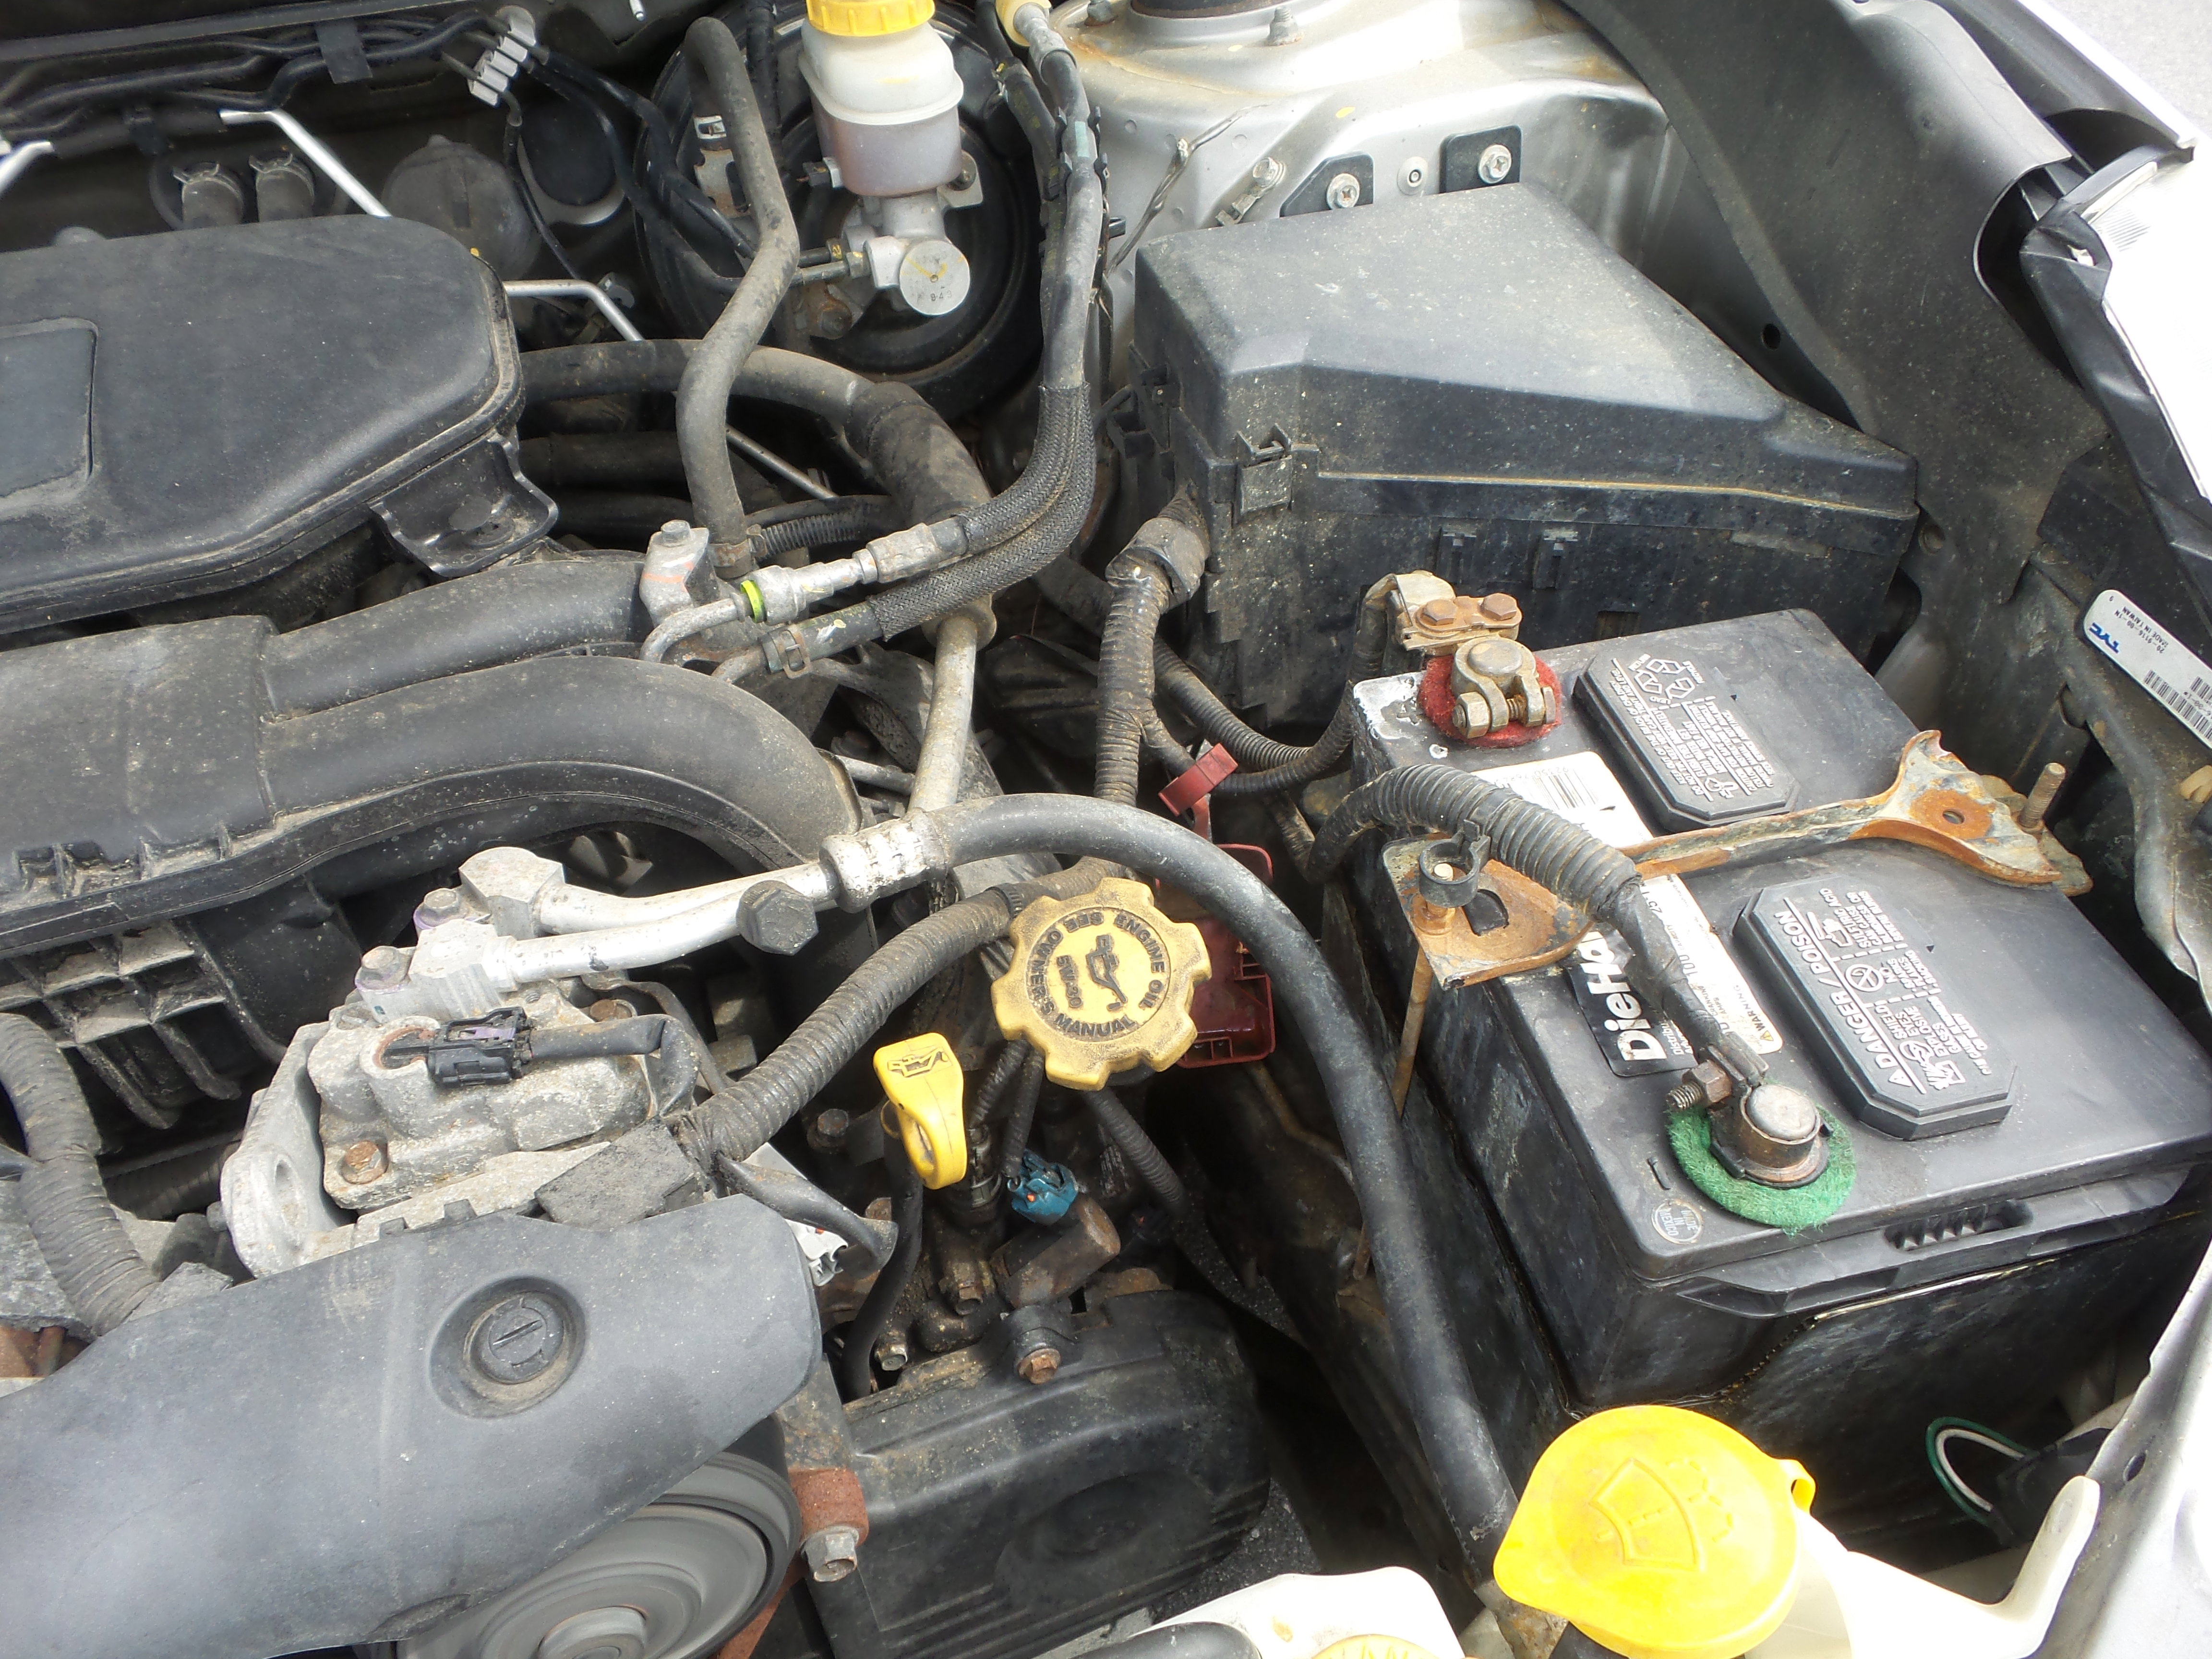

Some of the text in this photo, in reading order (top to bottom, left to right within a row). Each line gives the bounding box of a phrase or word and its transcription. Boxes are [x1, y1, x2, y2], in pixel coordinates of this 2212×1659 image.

[2123, 607, 2143, 626] TAIWAN
[2089, 623, 2118, 653] TYC
[2152, 633, 2168, 647] MADE
[1683, 661, 1705, 684] RECYCLE
[1622, 685, 1635, 696] AND
[1649, 696, 1671, 705] LEAD
[1630, 697, 1647, 713] TIGHT
[1633, 716, 1651, 734] REACH
[1642, 714, 1658, 729] CAPS
[1646, 734, 1659, 746] THE
[1652, 730, 1669, 744] VENT
[1653, 710, 1707, 777] FLUSH EYES IMMEDIATELY
[1677, 729, 1691, 739] GET
[1731, 735, 1742, 743] IF
[1655, 746, 1666, 755] OF
[1663, 744, 1679, 759] KEEP
[1683, 721, 1727, 773] MEDICAL HELP FAST
[1716, 743, 1731, 756] SAFE
[1744, 741, 1765, 760] SERVICE
[1661, 756, 1675, 769] OUT
[1700, 760, 1717, 775] WITH
[1726, 756, 1739, 768] FOR
[1760, 761, 1775, 774] SEEK
[1670, 769, 1687, 784] KEEP
[1683, 773, 1696, 785] NOT
[1744, 767, 1765, 787] FOLLOW
[1691, 785, 1704, 794] DO
[1064, 912, 1104, 932] SEE
[1820, 888, 1871, 947] SULFURIC ACID
[1845, 905, 1885, 945] CAN CAUSE
[1847, 892, 1893, 943] BLINDNESS OR
[1859, 891, 1903, 940] SEVERE BURNS
[1114, 913, 1165, 1009] ENGINE OIL
[1905, 950, 1936, 983] SMOKING
[1877, 966, 1898, 983] NO
[1885, 958, 1915, 988] SPARKS
[1898, 957, 1925, 986] FLAMES
[1775, 911, 1897, 1069] DANGER / POISON
[1732, 985, 1766, 1031] WARNING
[1928, 996, 1961, 1034] BLINDNESS
[1054, 1013, 1138, 1037] MANUAL
[1873, 1005, 1907, 1038] SHIELD
[1895, 1011, 1920, 1036] EYES
[1904, 1006, 1949, 1056] EXPLOSIVE
[1952, 1013, 1987, 1050] OR INJURY
[1660, 1022, 1684, 1055] Distribu
[1933, 1022, 1961, 1053] GASES
[1955, 1034, 1980, 1058] CAUSE
[1659, 1209, 1678, 1236] MEXICO
[1674, 1217, 1684, 1226] IN
[1682, 1210, 1696, 1230] MADE
